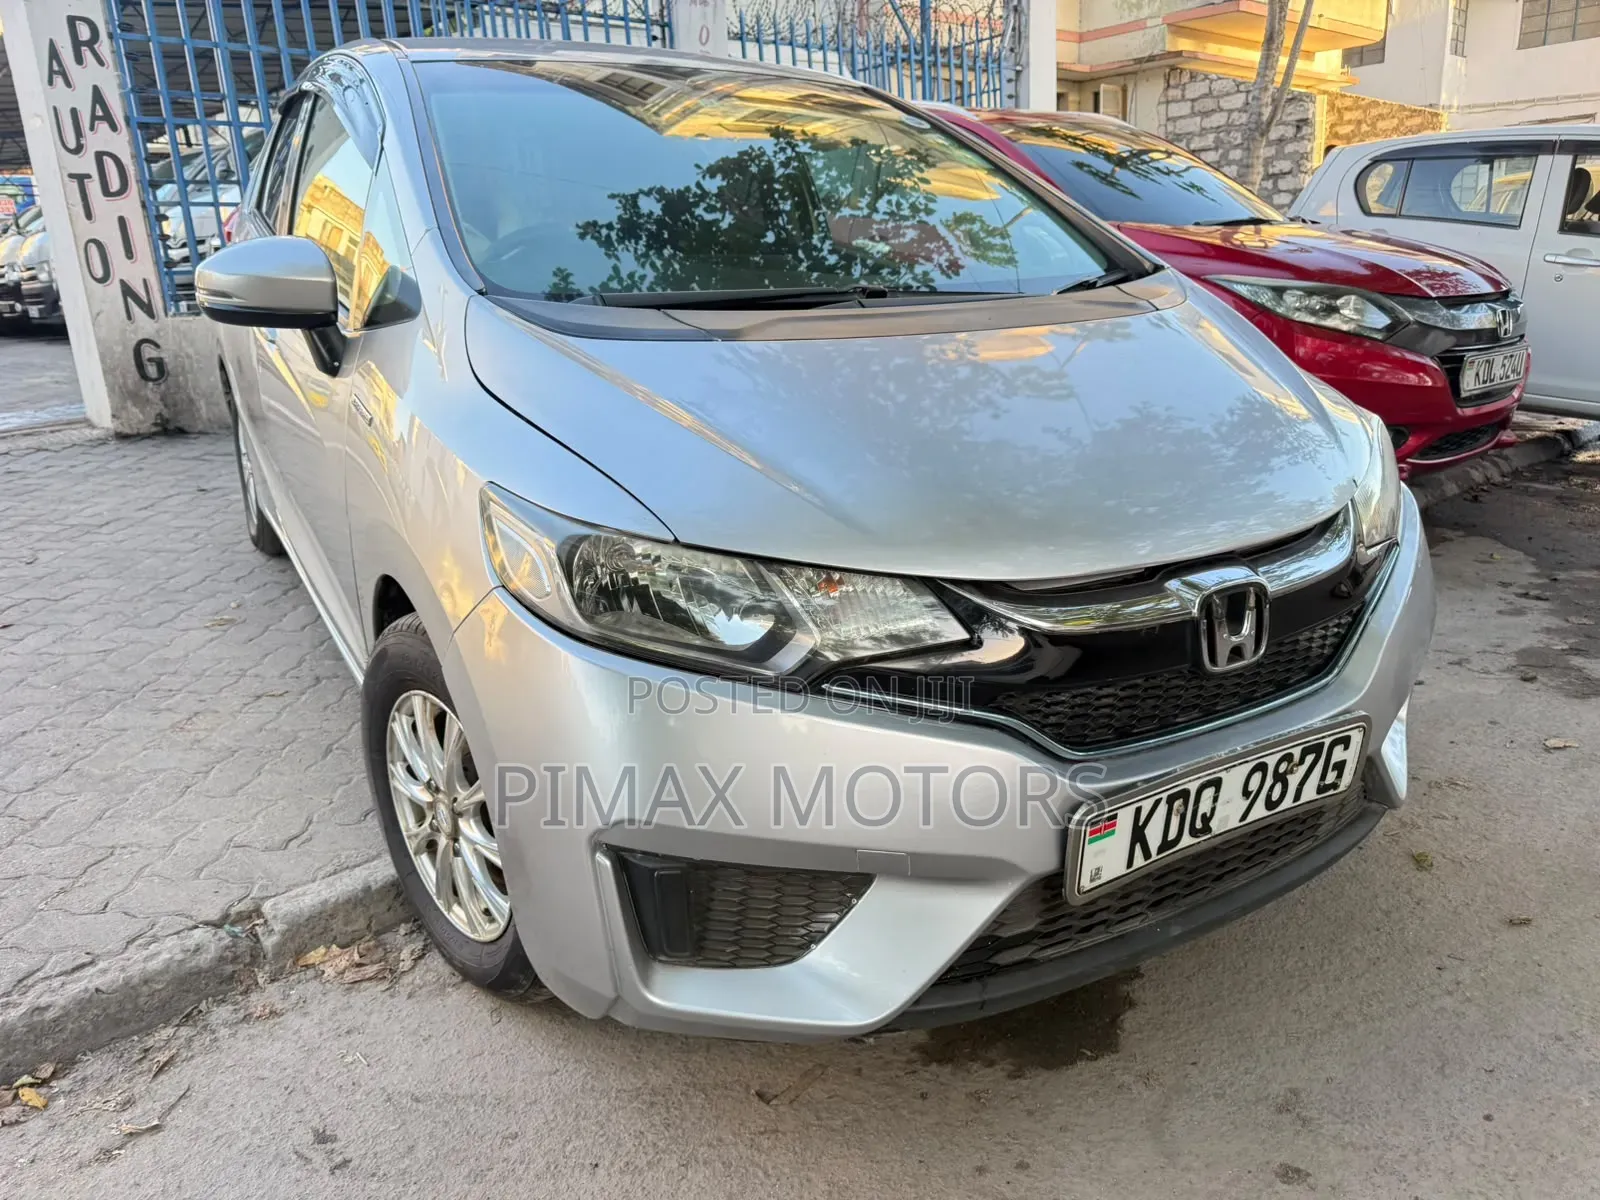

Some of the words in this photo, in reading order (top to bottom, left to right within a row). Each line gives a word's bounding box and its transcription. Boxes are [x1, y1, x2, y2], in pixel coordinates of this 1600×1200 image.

[47, 37, 112, 286] AUTO
[66, 14, 168, 383] RADING
[1474, 357, 1496, 387] KDL
[1126, 776, 1223, 870] KDQ
[1238, 735, 1352, 823] 987G
